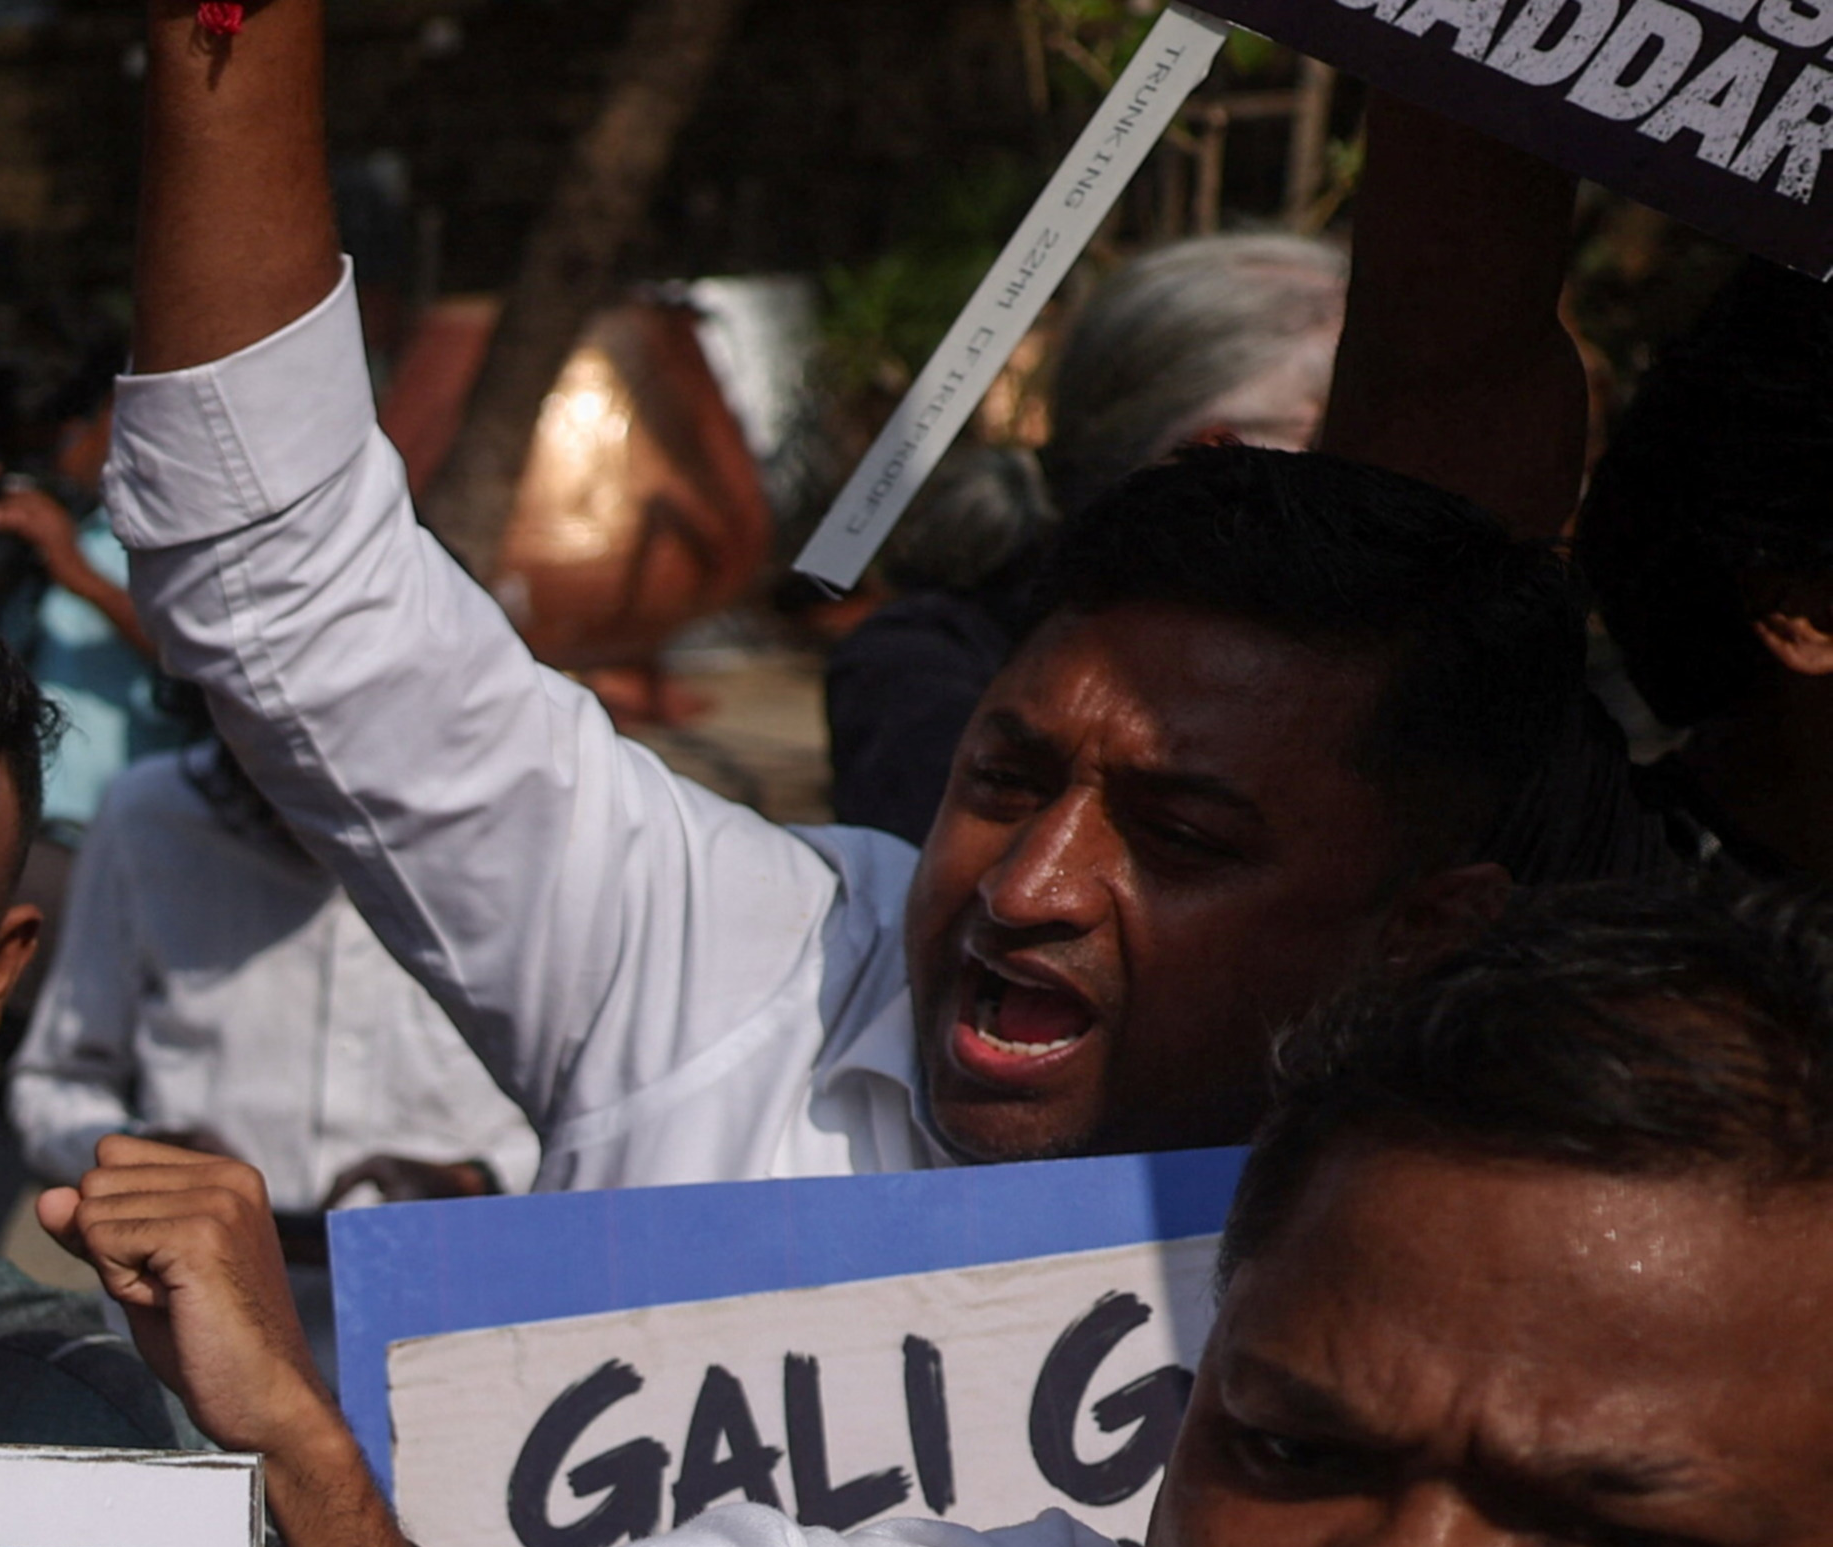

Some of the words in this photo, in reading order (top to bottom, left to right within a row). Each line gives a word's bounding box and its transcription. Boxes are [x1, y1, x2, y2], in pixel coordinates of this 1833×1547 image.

[1064, 46, 1186, 209] TRUNKING
[1341, 0, 1833, 204] ADDAR
[998, 228, 1060, 309] 22MM
